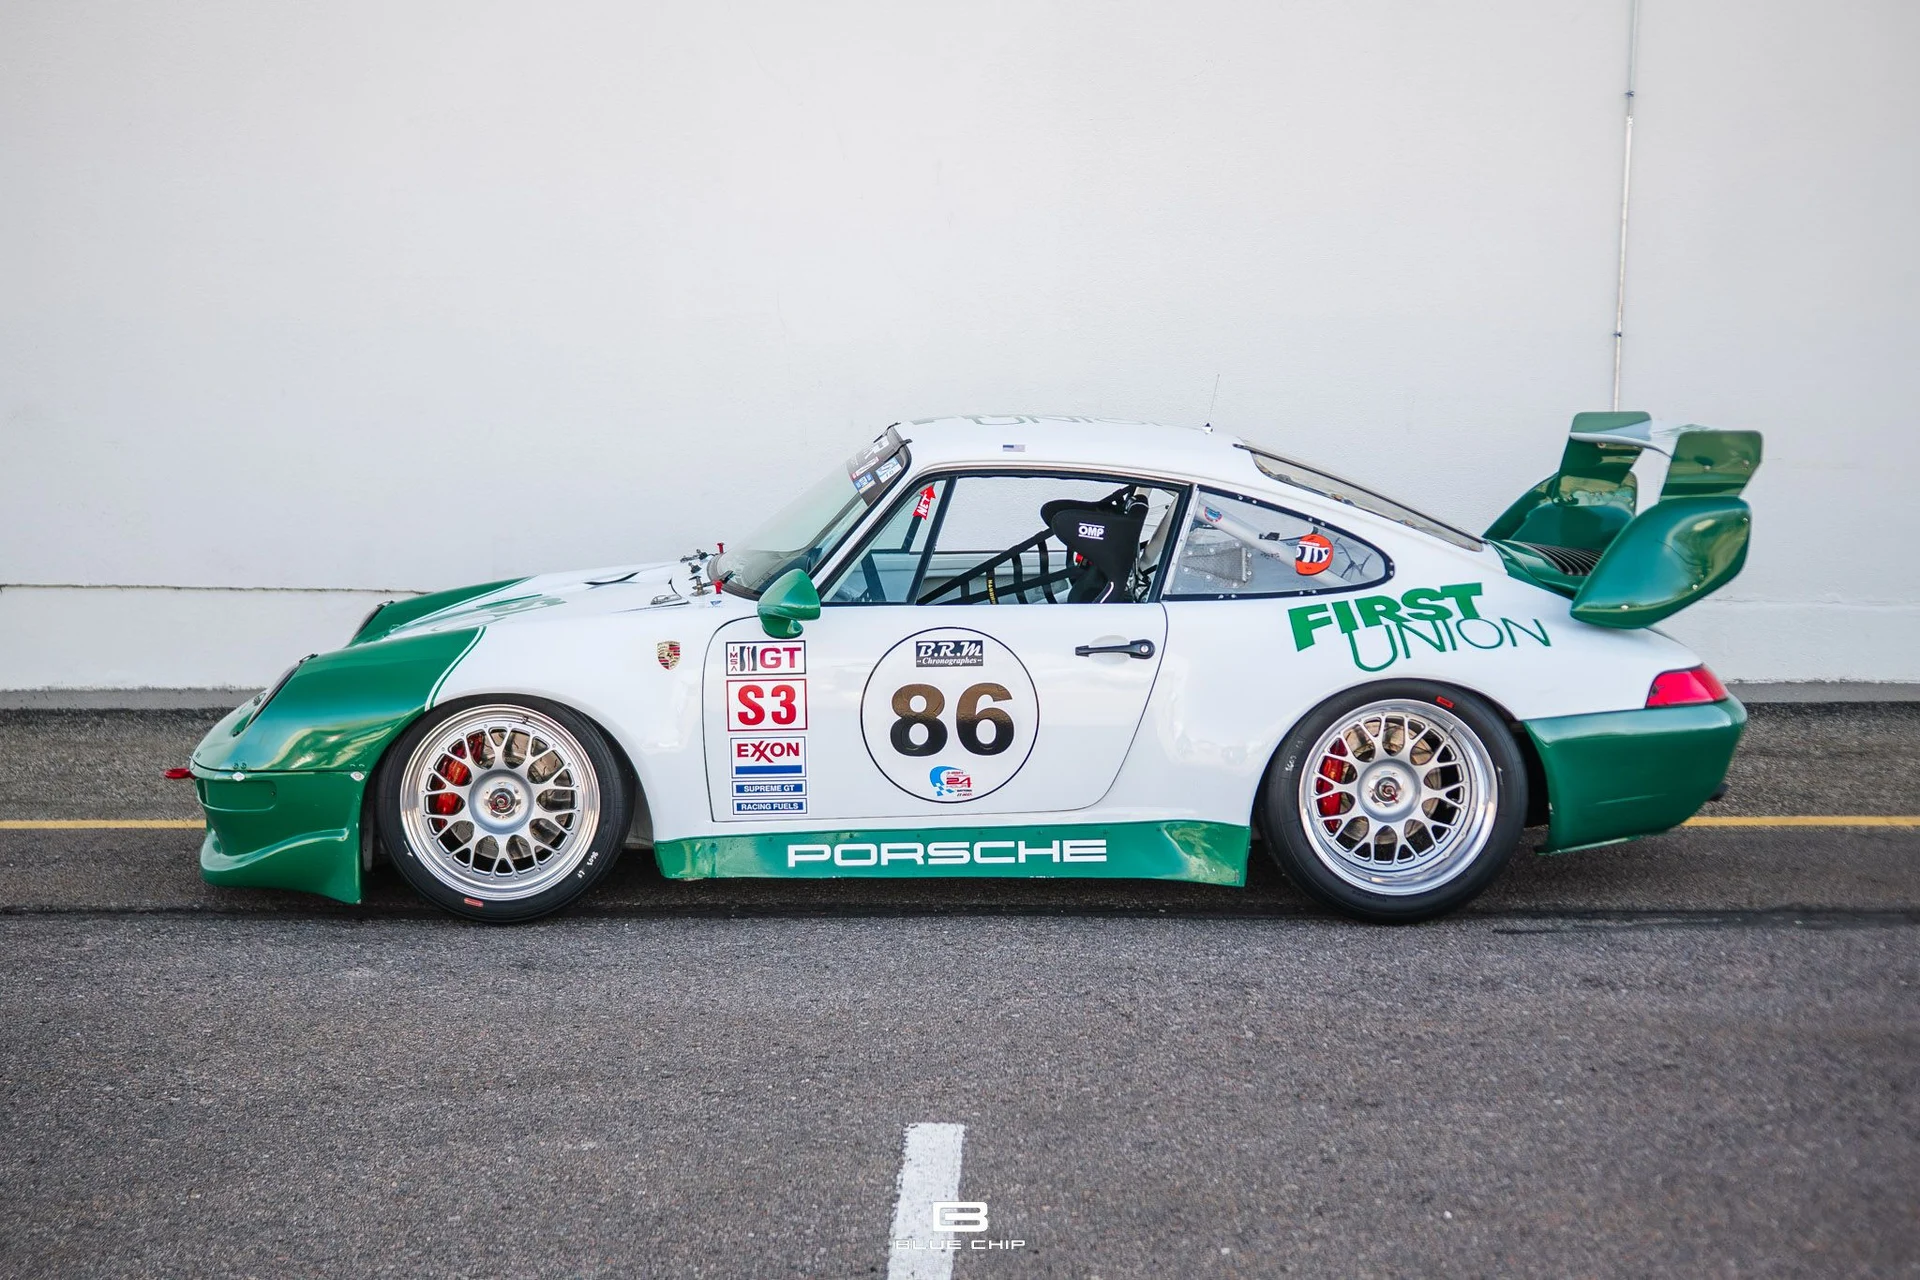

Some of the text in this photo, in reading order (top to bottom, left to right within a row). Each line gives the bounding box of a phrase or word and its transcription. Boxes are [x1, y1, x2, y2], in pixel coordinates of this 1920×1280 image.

[917, 494, 930, 516] NET
[1078, 525, 1105, 537] OMP
[1288, 582, 1483, 652] FIRST
[1346, 617, 1552, 672] UNION
[729, 646, 738, 672] IMSA
[760, 646, 802, 669] GT
[737, 684, 797, 726] S3
[890, 682, 1015, 757] 86
[737, 740, 800, 763] EXXON
[744, 784, 795, 793] SUPREME GT
[946, 777, 972, 788] 24
[741, 802, 799, 811] RACING FUELS
[787, 839, 1107, 868] PORSCHE
